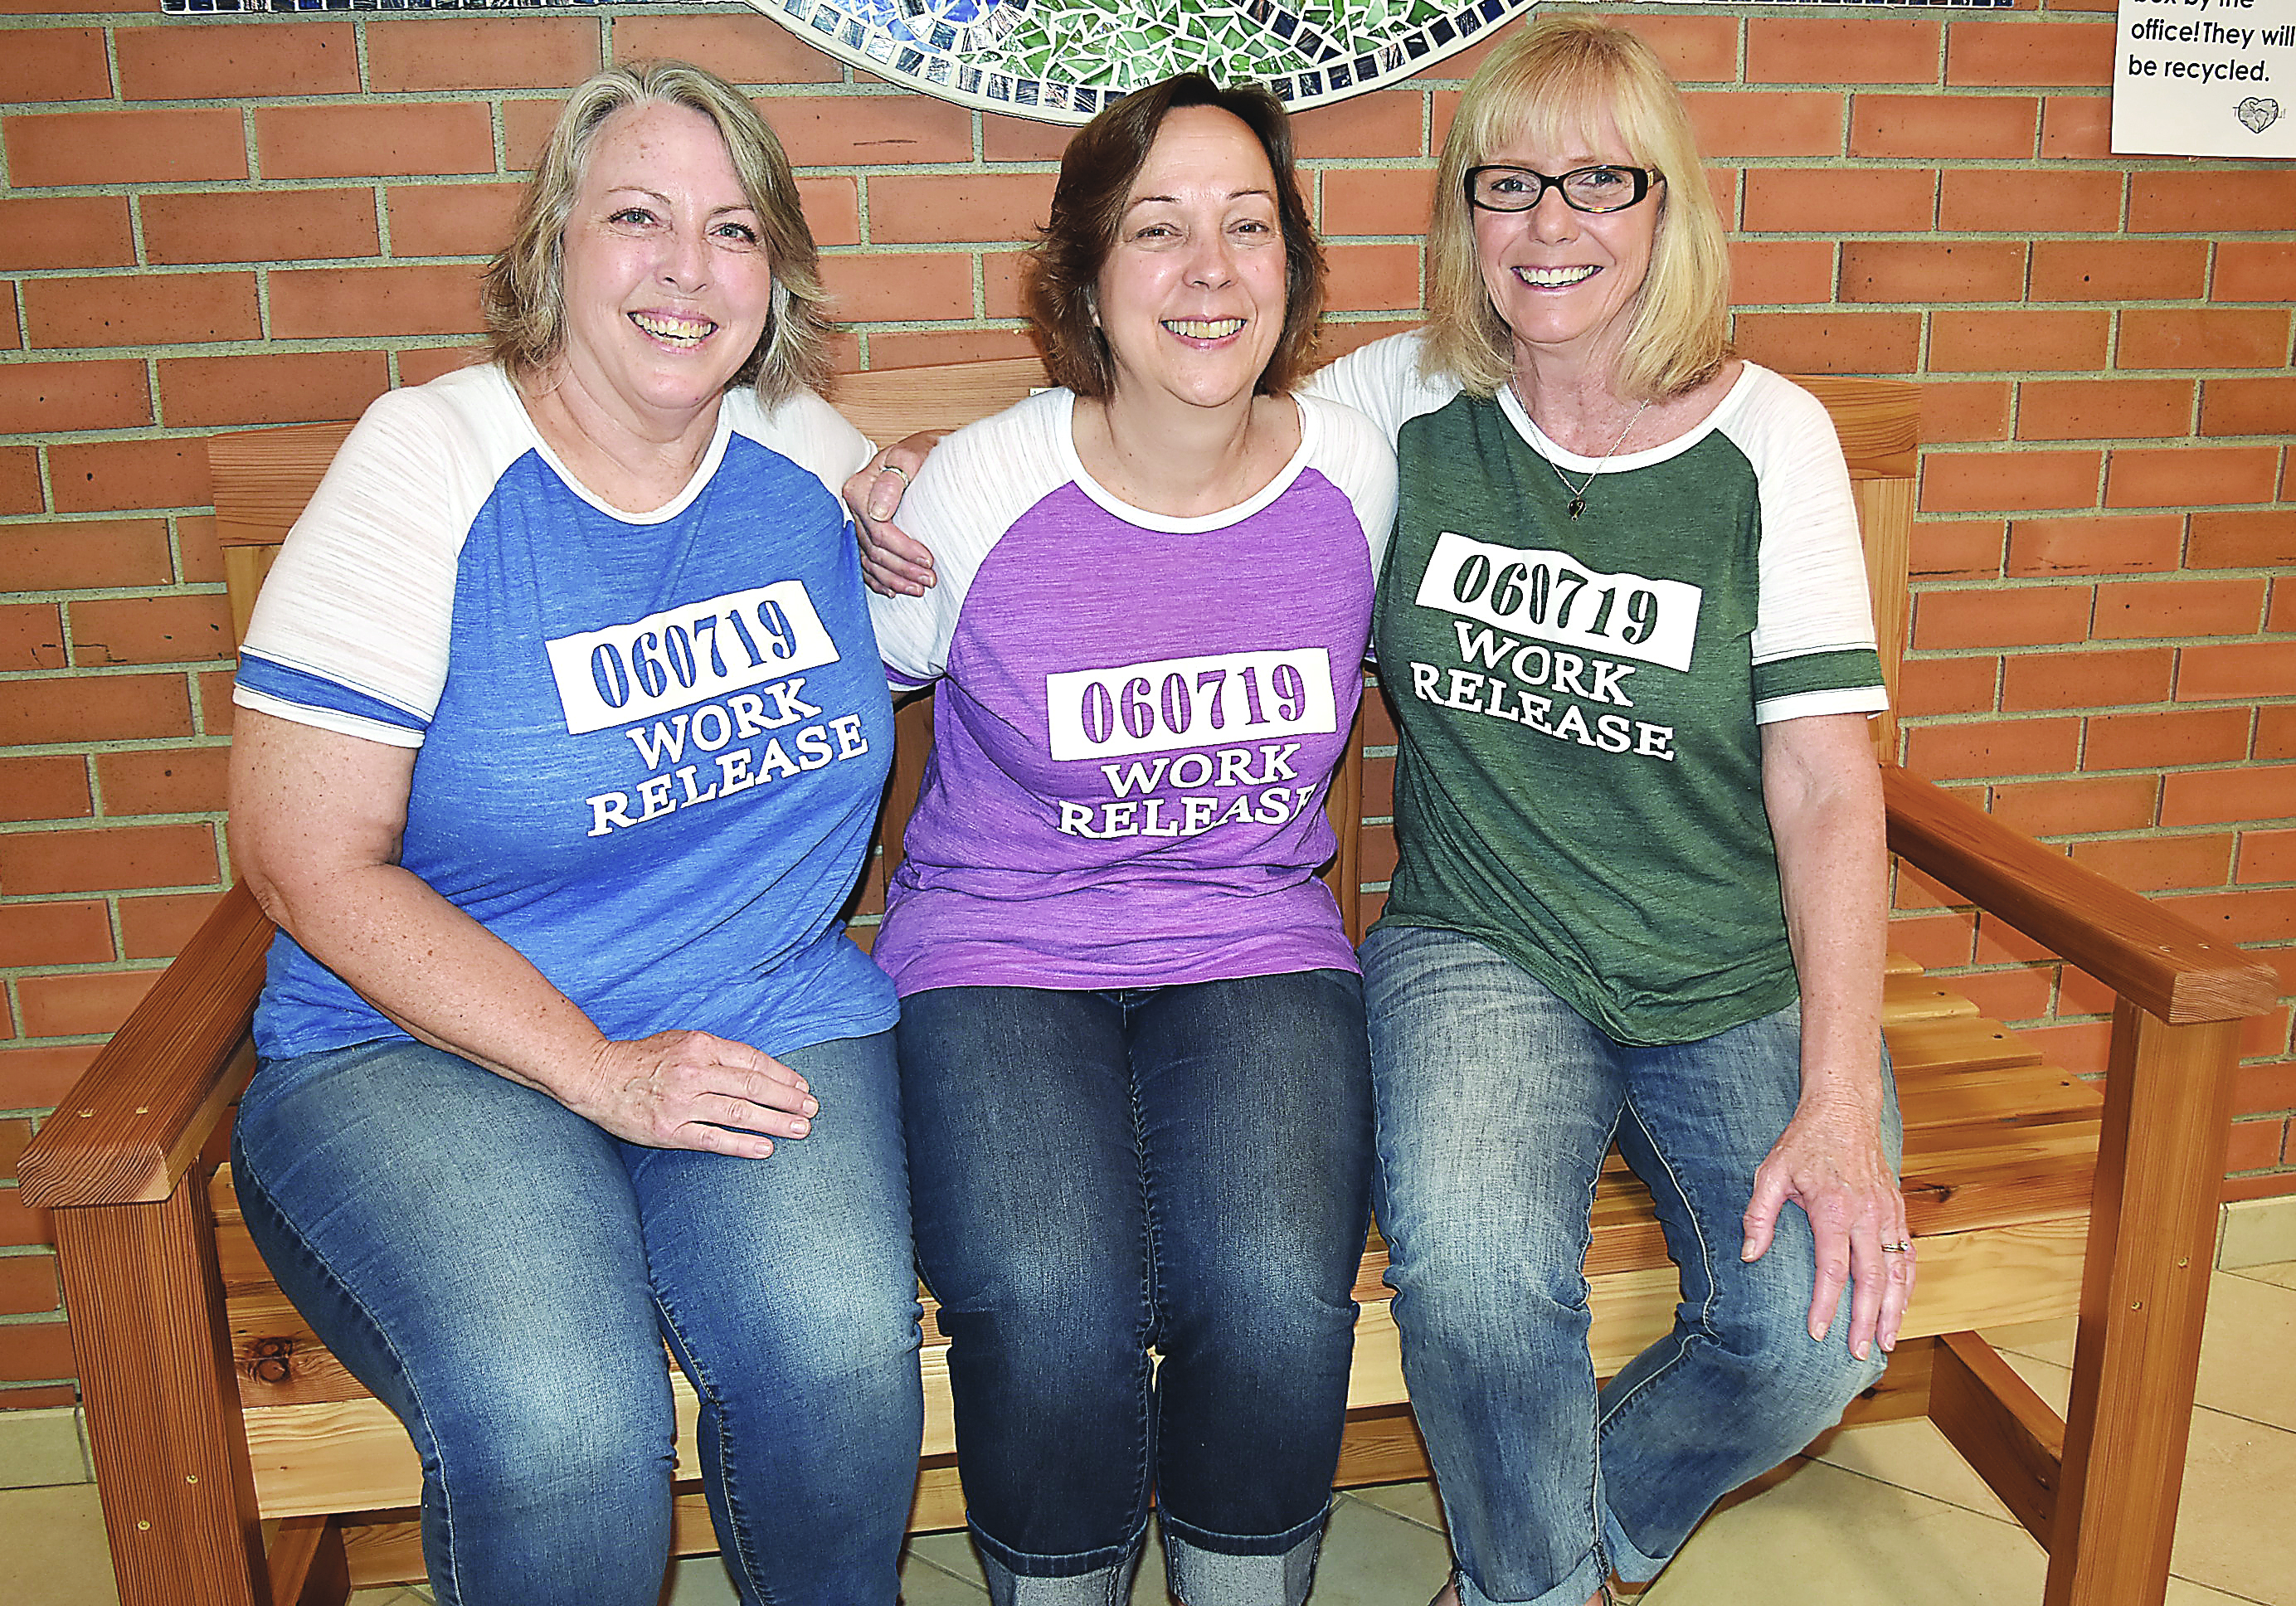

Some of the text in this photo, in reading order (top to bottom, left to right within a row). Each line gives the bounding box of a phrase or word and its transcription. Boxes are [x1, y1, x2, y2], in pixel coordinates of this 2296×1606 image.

[2128, 54, 2269, 84] be recycled.
[2261, 26, 2296, 46] will
[1453, 554, 1658, 645] 060719
[591, 601, 796, 708] 060719
[1453, 620, 1636, 707] WORK
[625, 678, 822, 770] WORK
[1081, 664, 1306, 743] 060719
[1410, 661, 1675, 762] RELEASE
[585, 713, 869, 837] RELEASE
[1101, 743, 1301, 798] WORK
